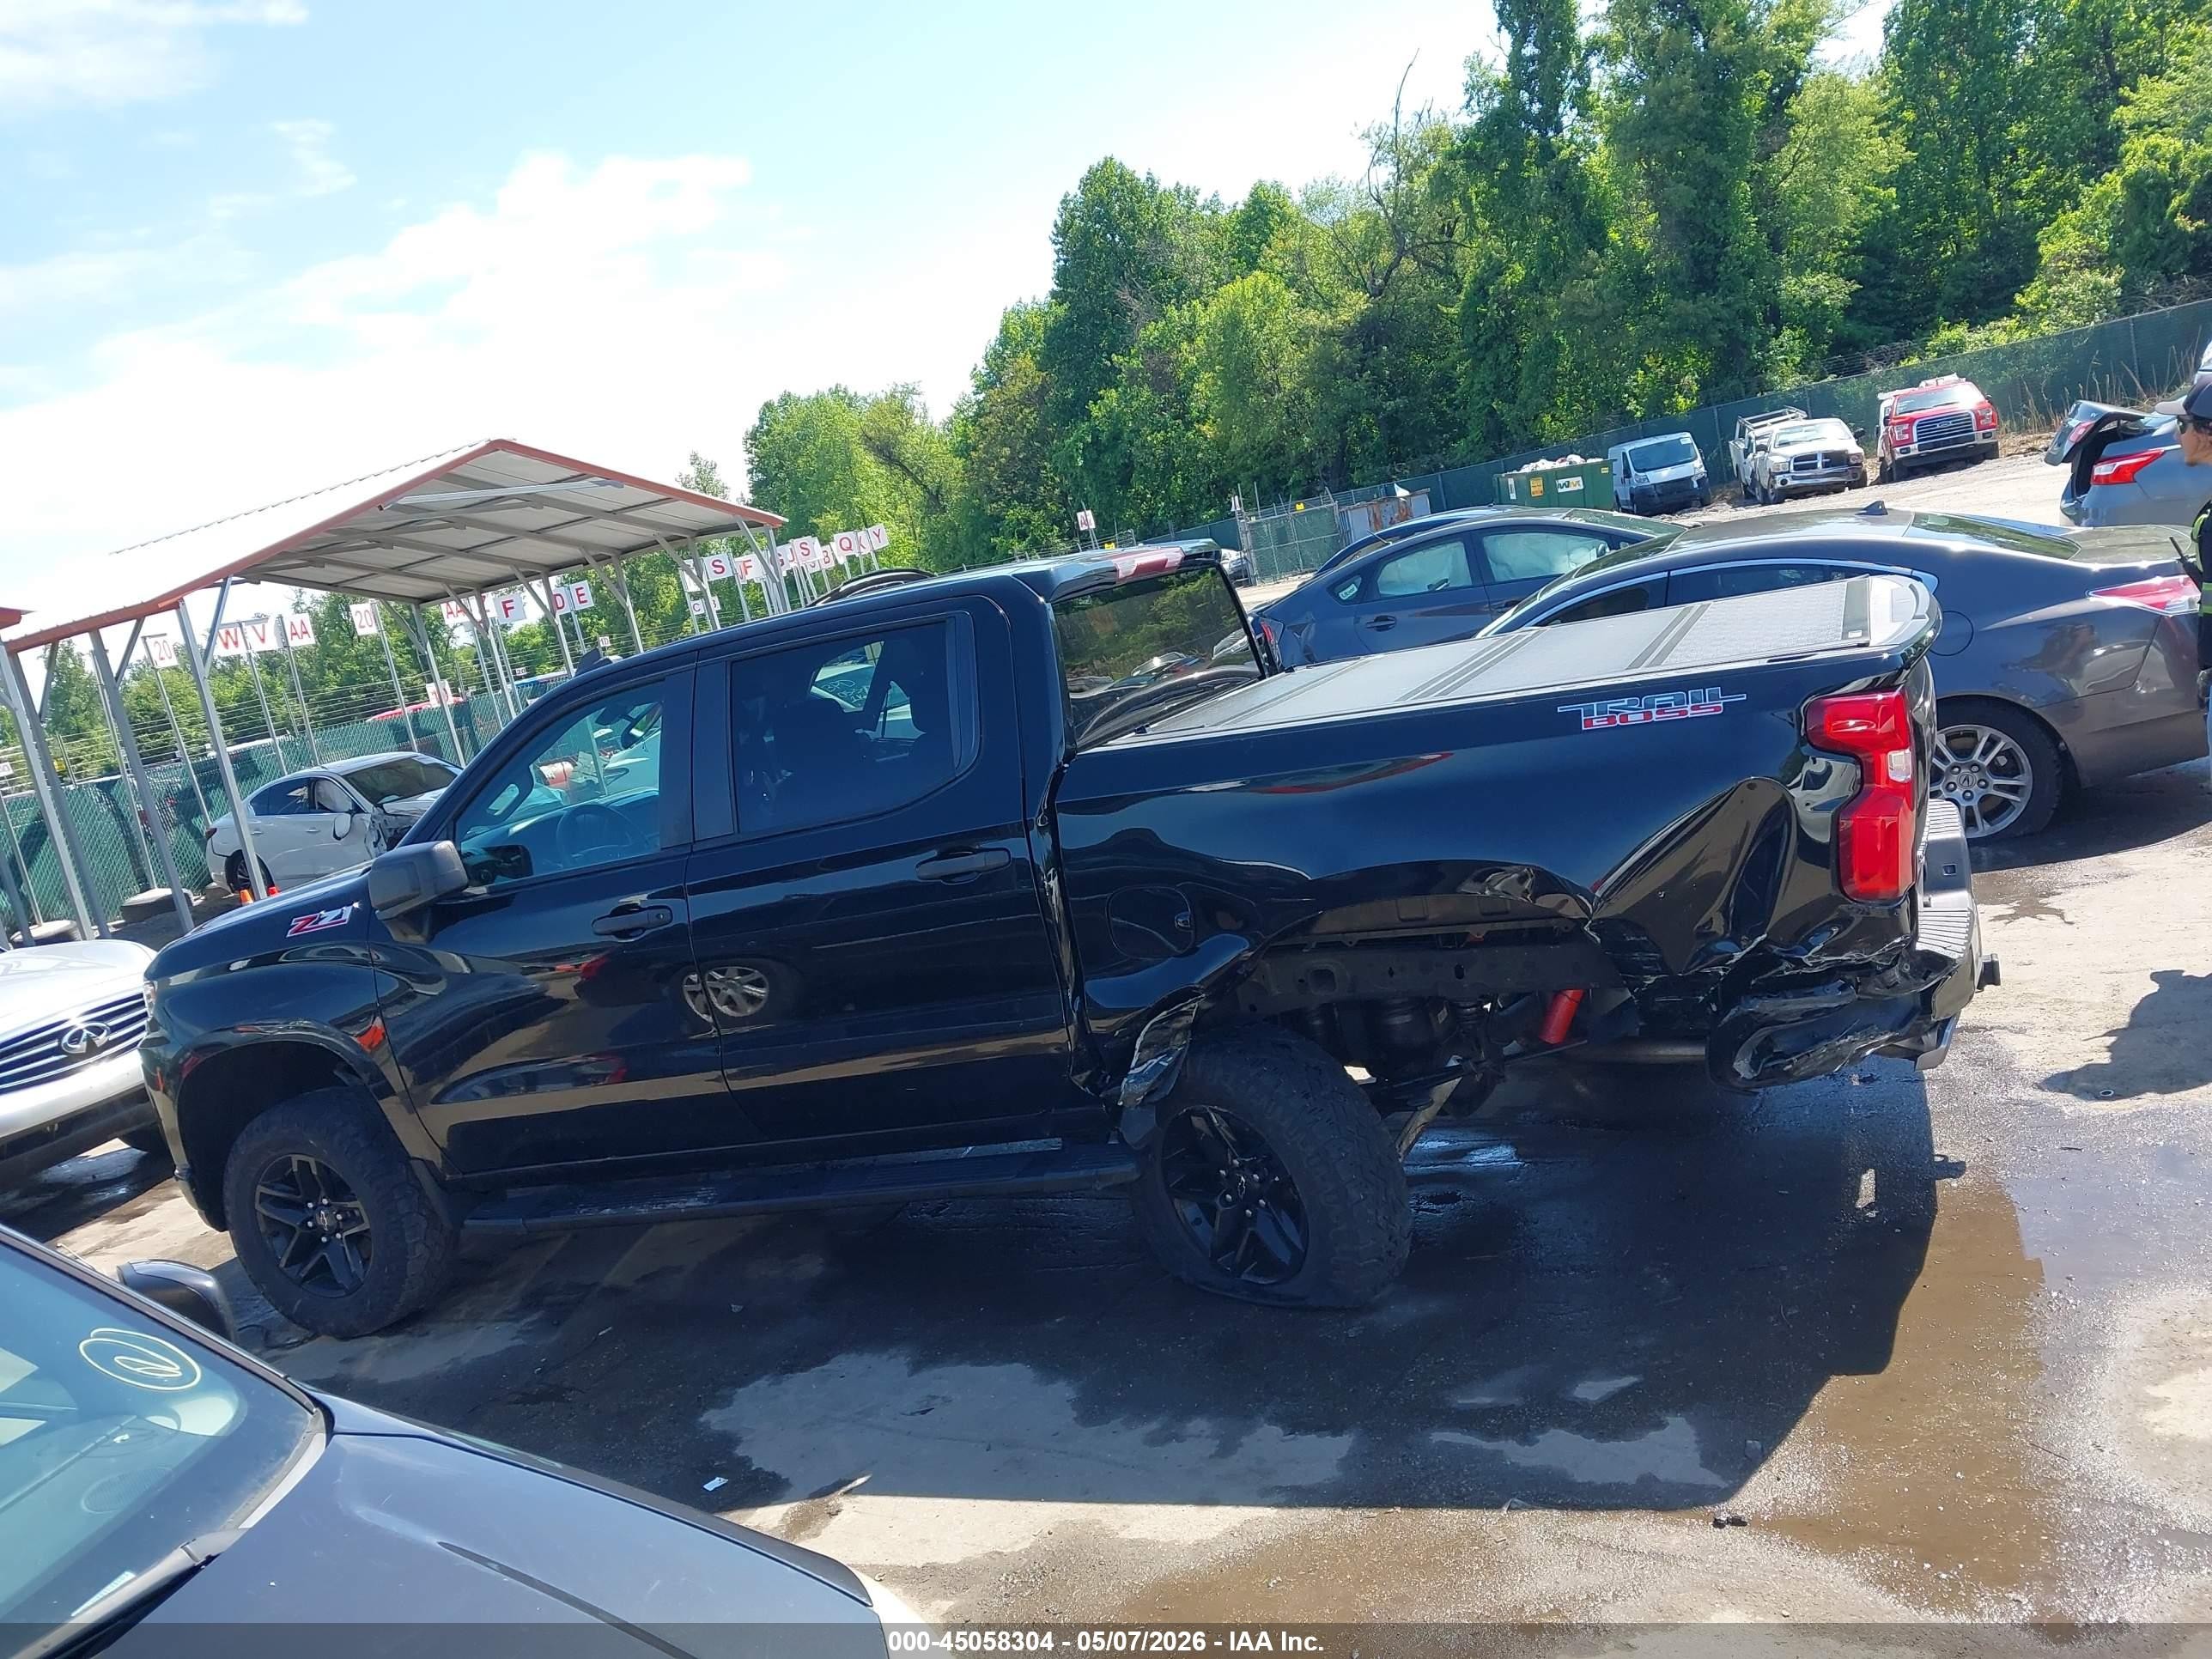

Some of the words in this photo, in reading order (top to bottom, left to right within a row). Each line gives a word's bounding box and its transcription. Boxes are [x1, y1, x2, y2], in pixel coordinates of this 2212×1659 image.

[839, 537, 854, 551] Q
[873, 528, 882, 543] Y
[799, 542, 811, 556] S
[711, 559, 726, 574] S
[743, 560, 752, 574] F
[552, 593, 565, 610] D
[575, 586, 588, 604] E
[501, 599, 514, 618] F
[355, 610, 374, 629] 20
[217, 626, 238, 650] W
[252, 623, 265, 644] V
[290, 619, 311, 641] AA
[154, 640, 173, 660] 20
[1558, 687, 1747, 721] TRAIL
[1582, 702, 1723, 730] BOSS
[286, 905, 353, 939] Z71
